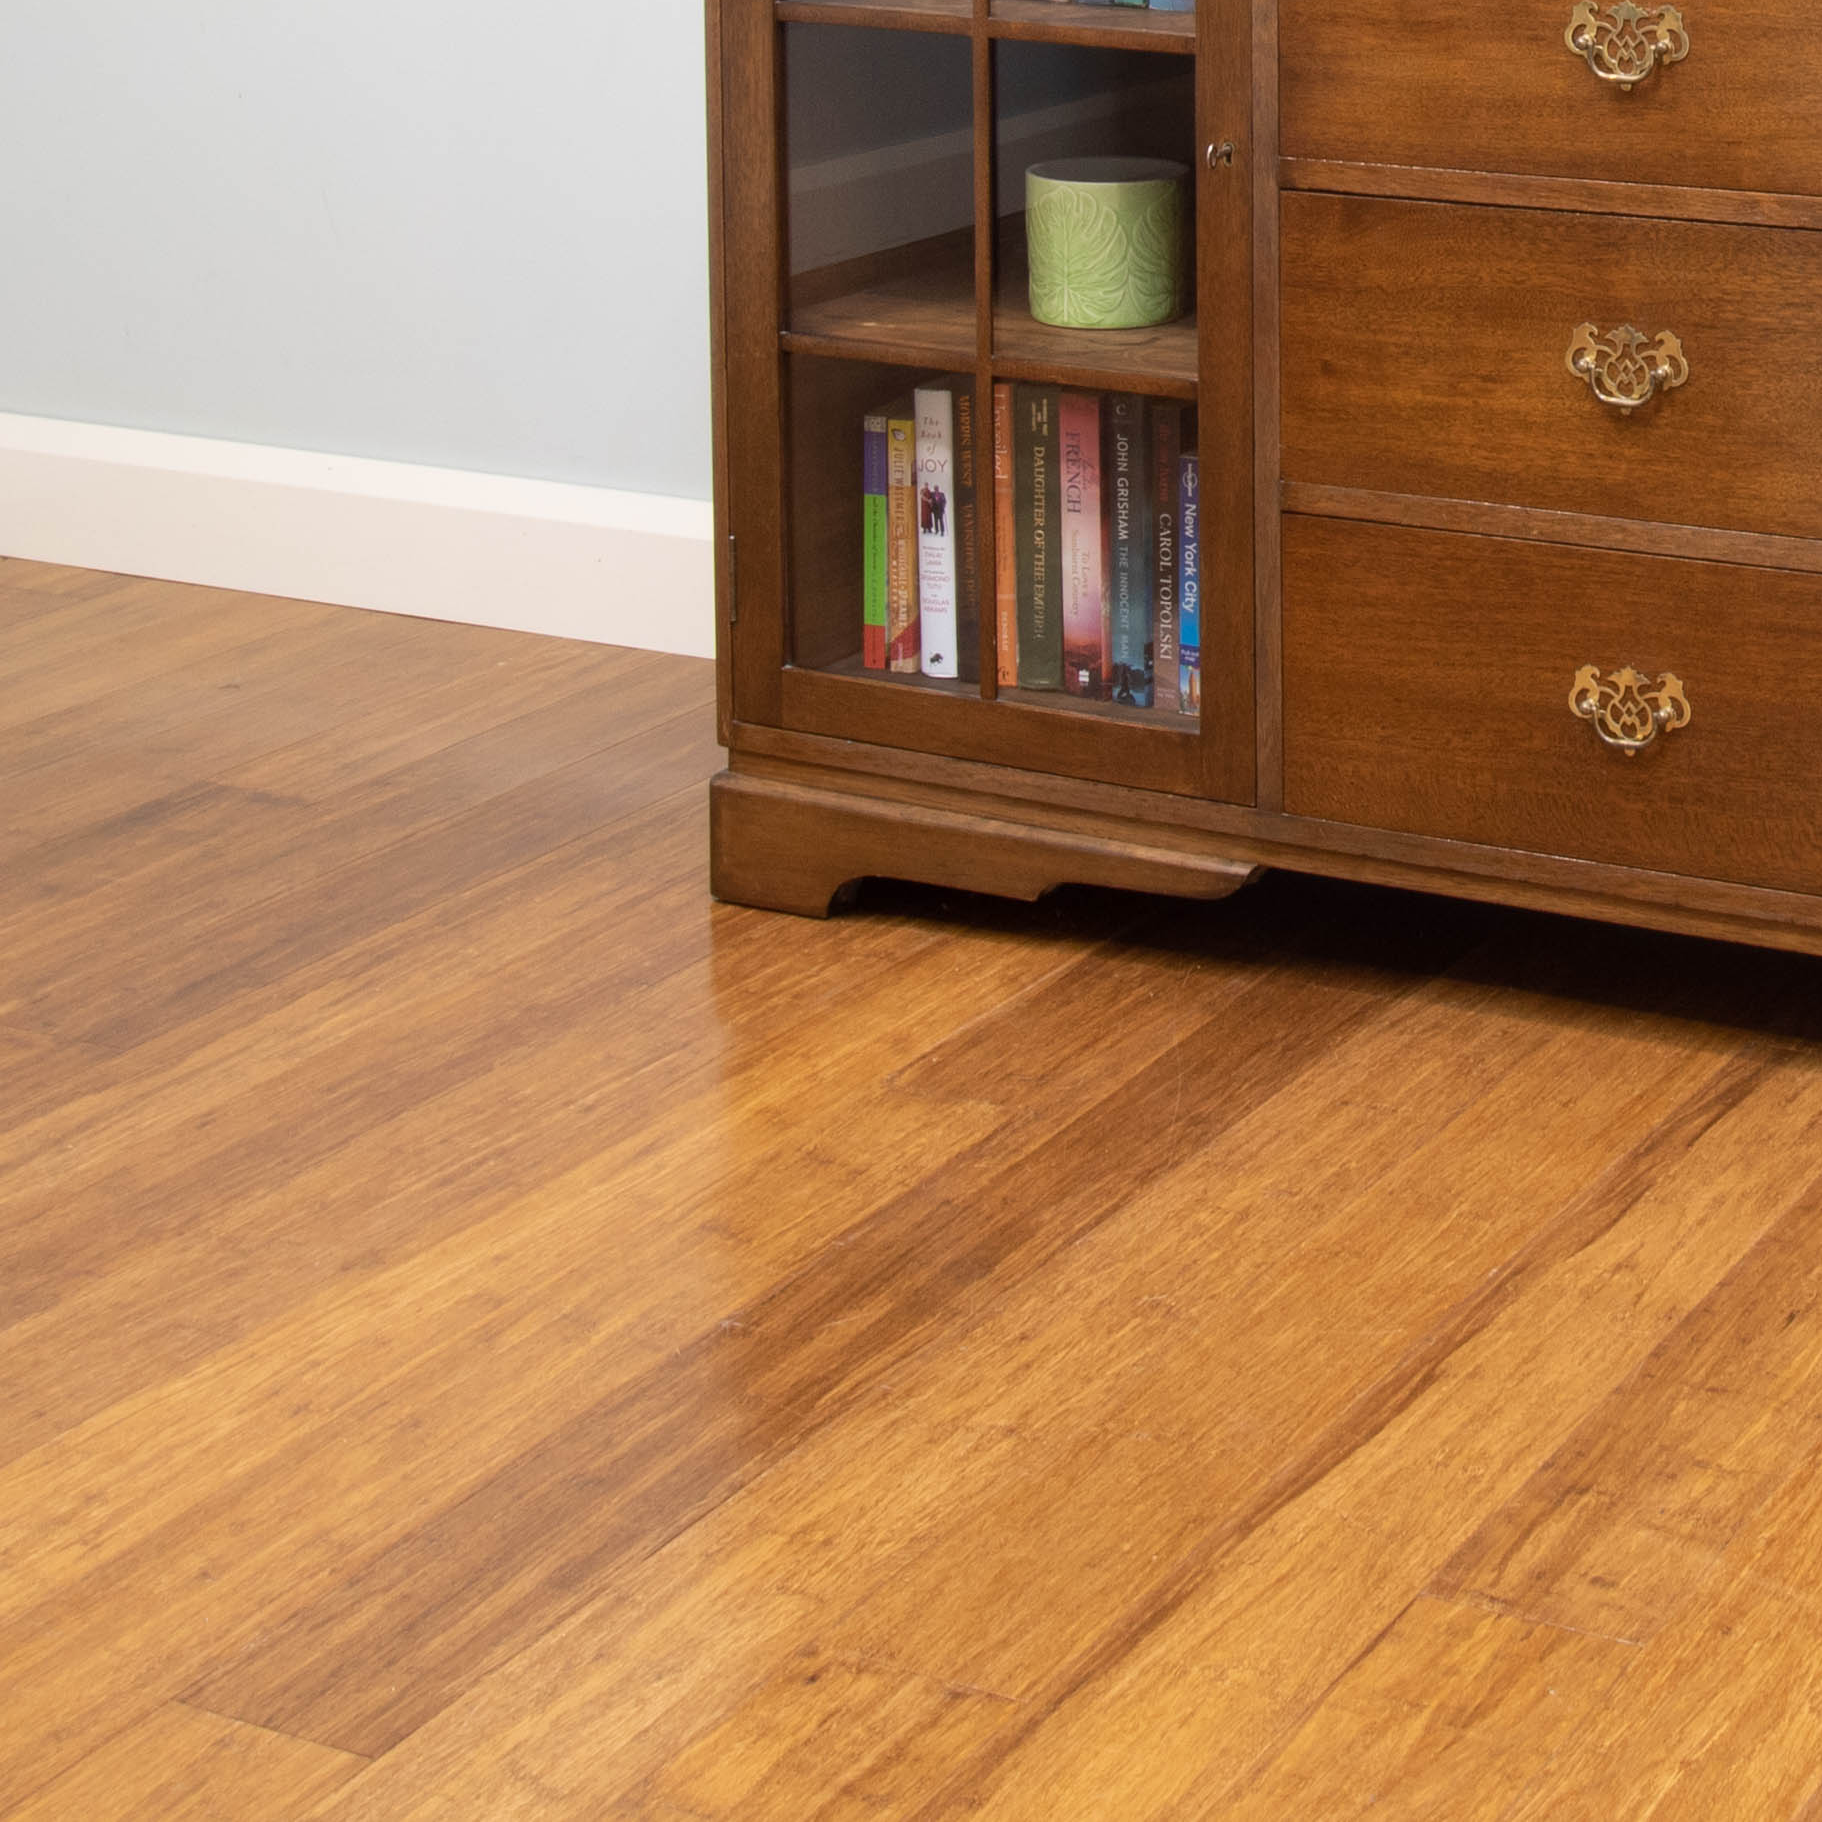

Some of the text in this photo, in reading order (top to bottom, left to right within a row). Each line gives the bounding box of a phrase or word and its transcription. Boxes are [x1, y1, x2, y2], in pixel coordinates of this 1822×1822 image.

[918, 458, 949, 474] JOY
[1065, 431, 1082, 514] FRENCH
[1032, 446, 1045, 527] DAUGHTER
[1116, 434, 1129, 540] JOHN GRISHAM
[1184, 503, 1197, 538] New
[1033, 530, 1046, 547] OF
[1159, 513, 1172, 571] CAROL
[1033, 550, 1045, 581] THE
[1118, 546, 1128, 569] THE
[1184, 542, 1198, 577] York
[1118, 572, 1129, 630] INNOCENT
[1182, 581, 1198, 613] City
[1159, 575, 1173, 660] TOPOLSKI
